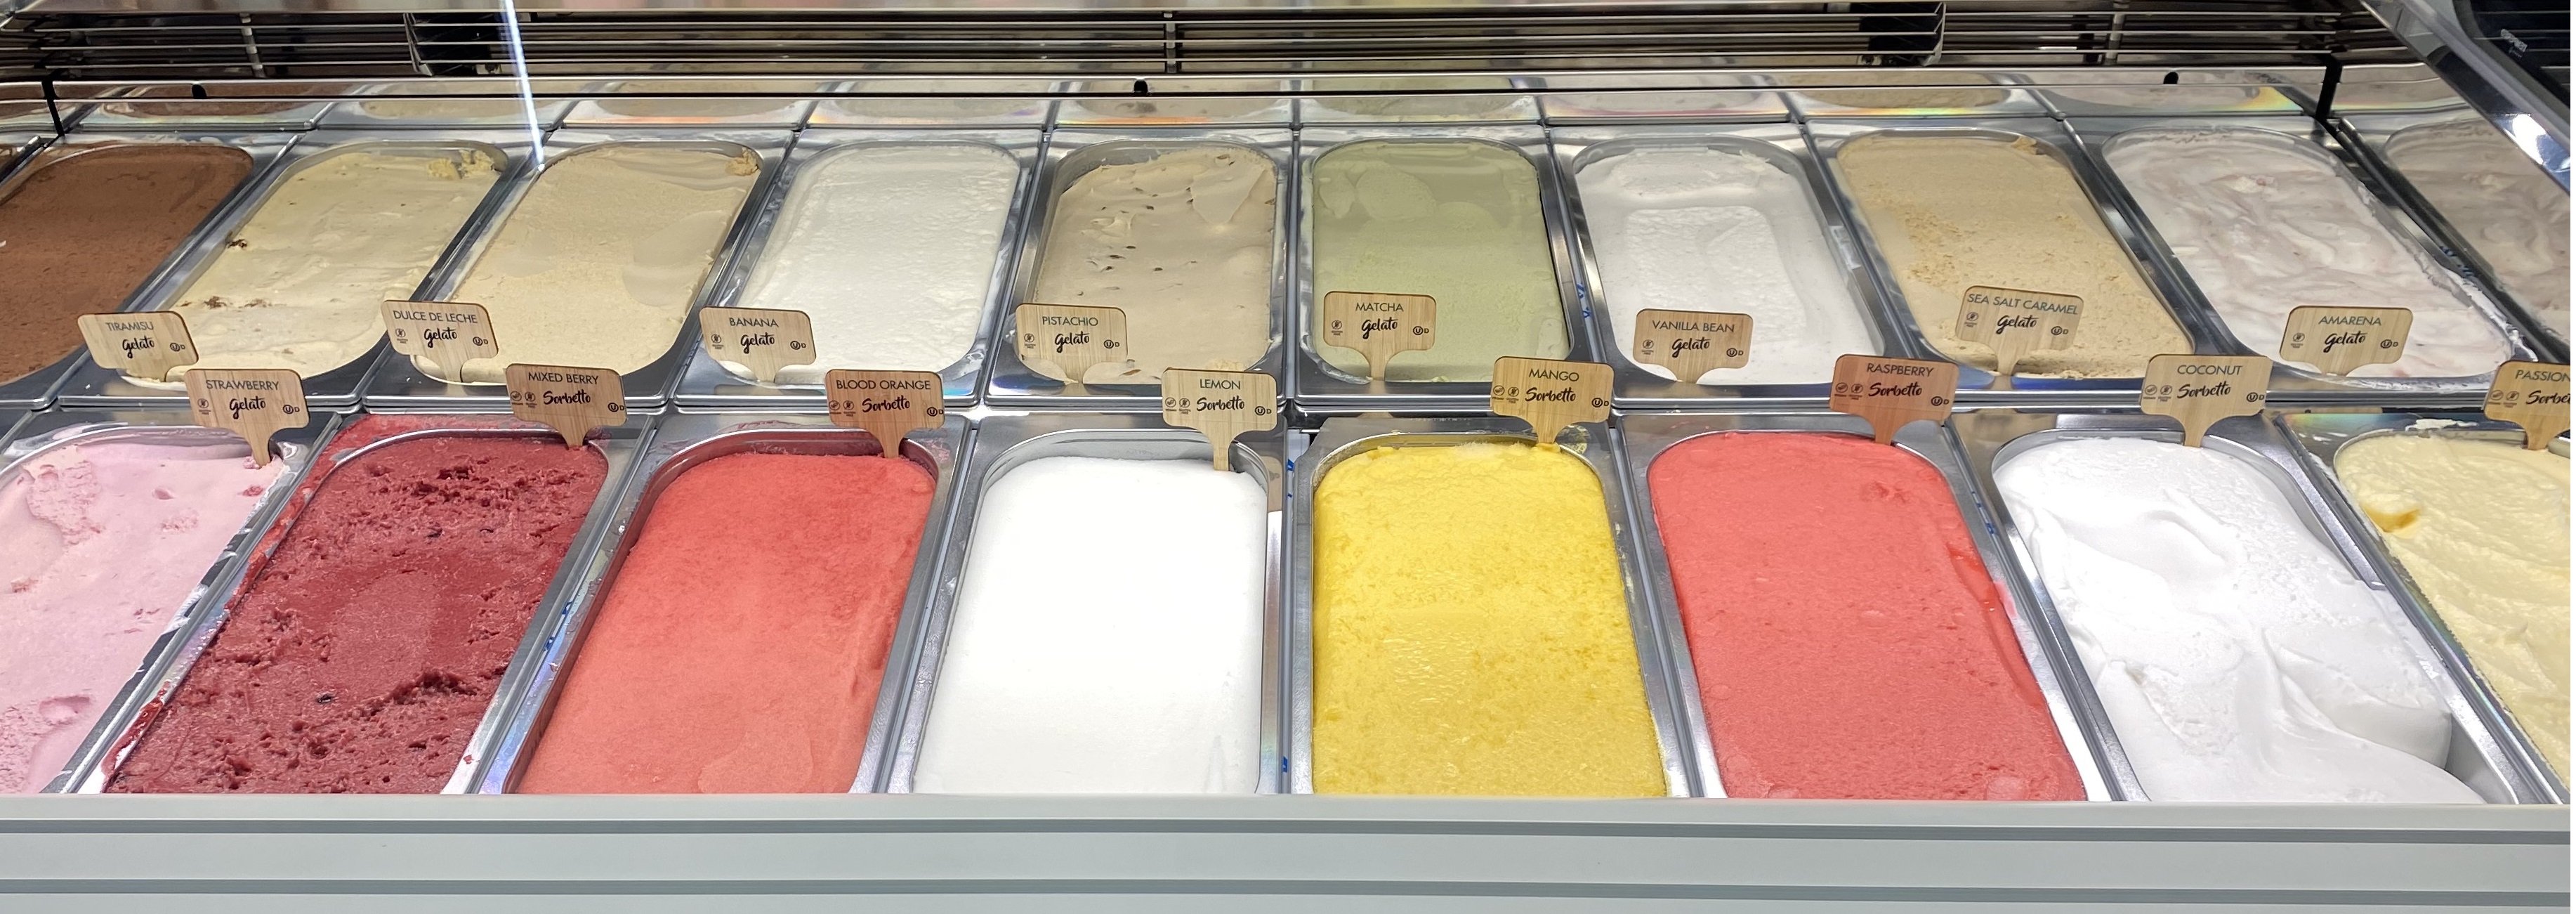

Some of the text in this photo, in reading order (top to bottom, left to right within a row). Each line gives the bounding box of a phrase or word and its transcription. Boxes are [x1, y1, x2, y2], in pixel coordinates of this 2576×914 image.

[1355, 303, 1404, 312] MATCHA
[1967, 294, 2079, 315] SEA SALT CARAMEL
[393, 311, 478, 324] DULCE DE LECHE
[729, 318, 779, 327] BANANA
[1042, 316, 1098, 326] PISTACHIO
[2318, 316, 2381, 326] AMARENA
[105, 322, 154, 331] TIRAMISU
[1652, 320, 1735, 333] VANILLA BEAN
[1528, 367, 1579, 381] MANGO
[1867, 363, 1935, 377] RASPBERRY
[2177, 365, 2243, 375] COCONUT
[528, 372, 598, 384] MIXED BERRY
[836, 379, 931, 390] BLOOD ORANGE
[1200, 379, 1240, 390] LEMON
[205, 379, 280, 391] STRAWBERRY
[1868, 381, 1922, 397] Sorbetto
[2177, 381, 2230, 399] Sorbetto
[543, 389, 591, 405] Sorbetto
[1525, 386, 1576, 403] Sorbetto
[862, 395, 909, 412] Sorbetto
[1197, 396, 1244, 411] Sorbetto
